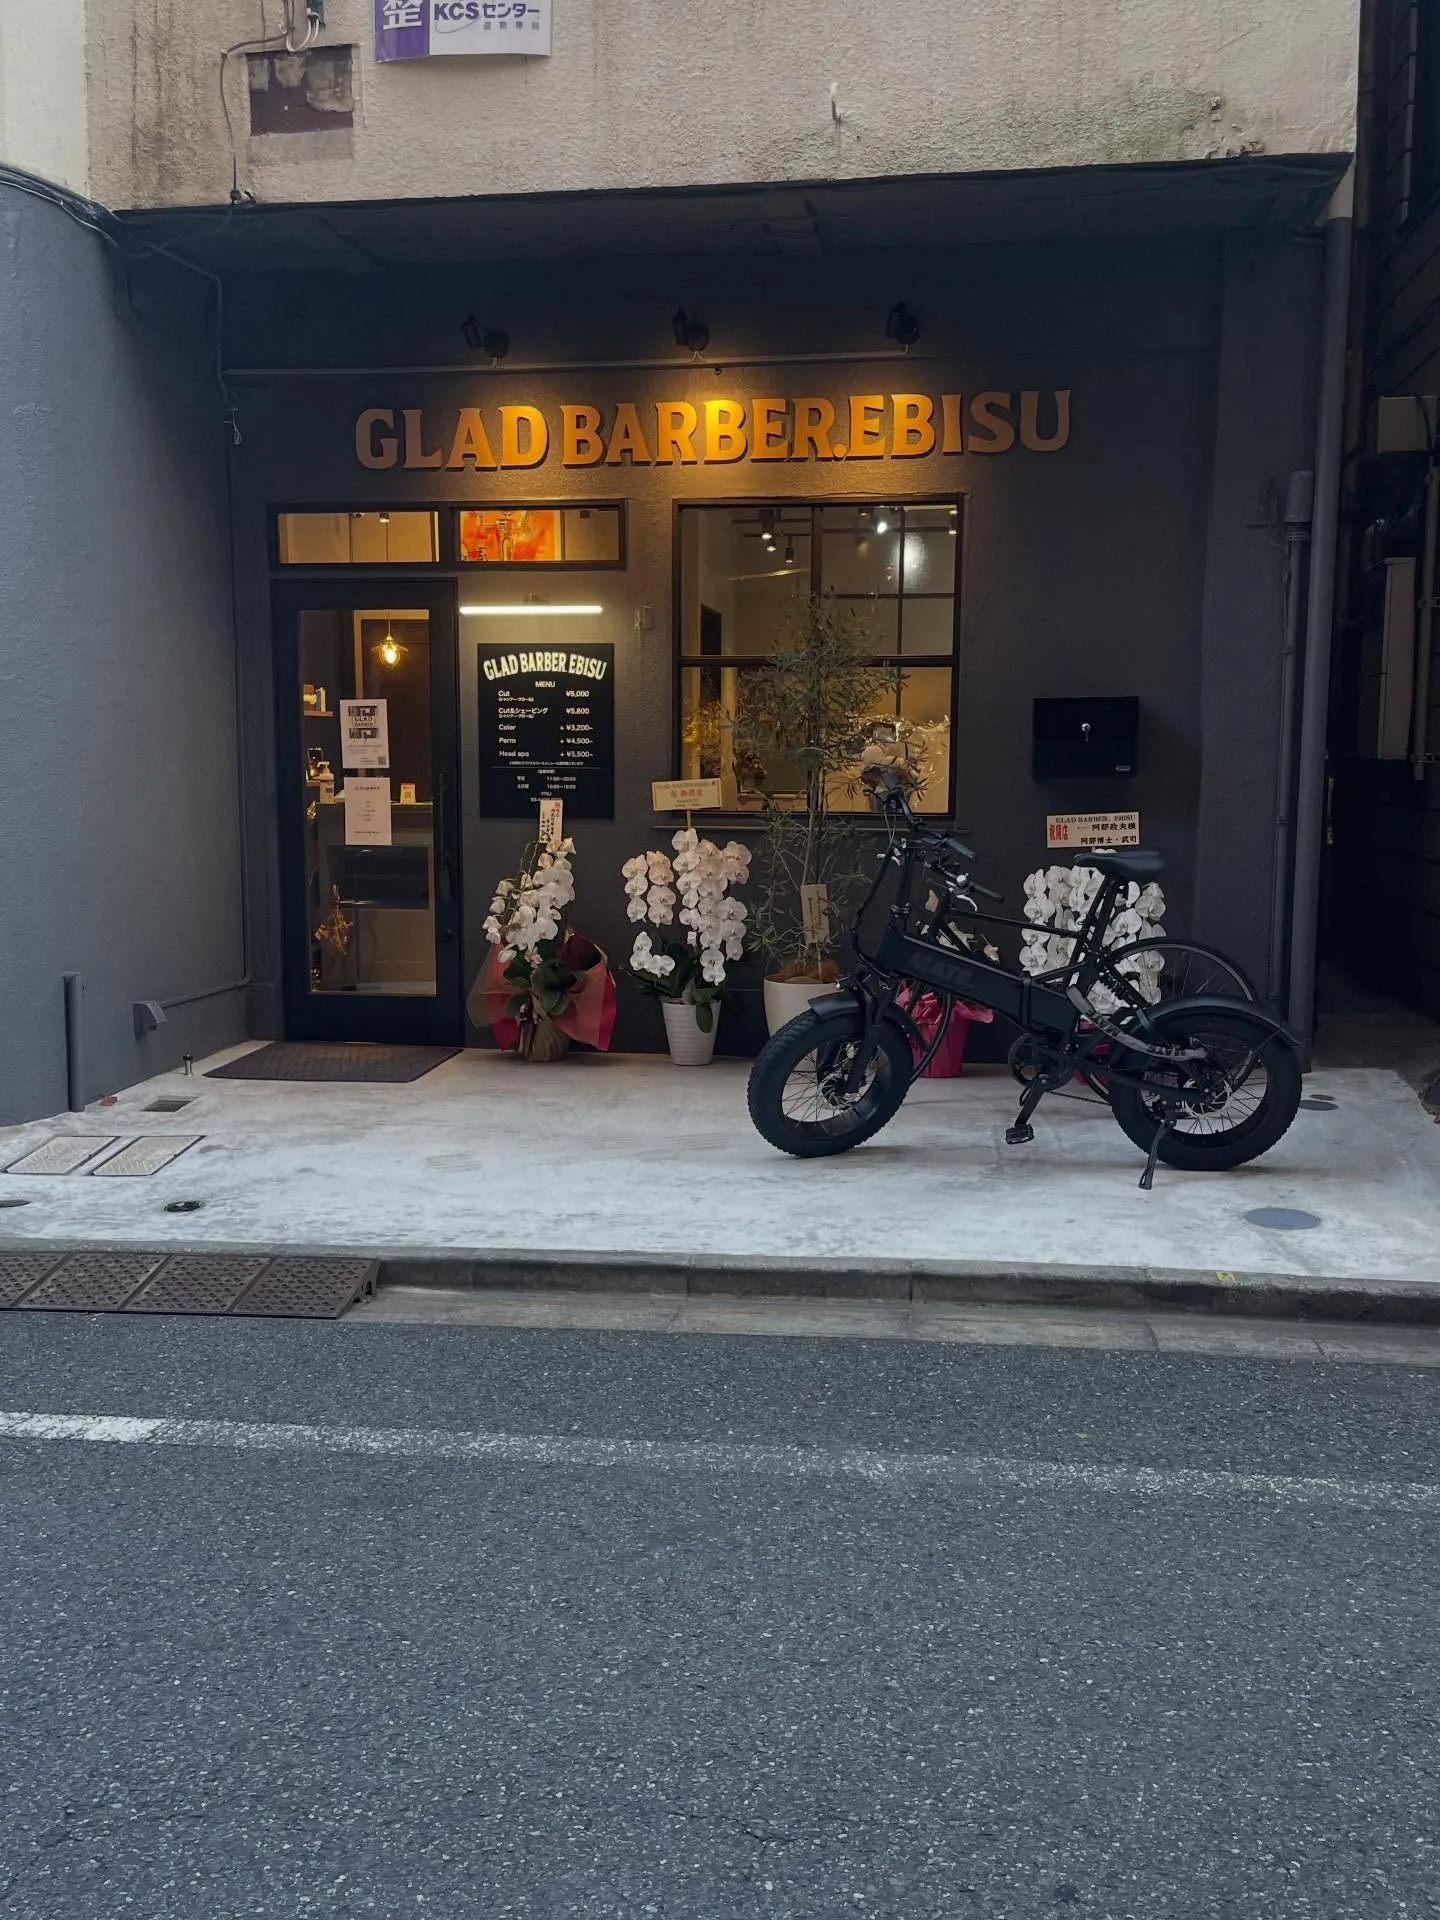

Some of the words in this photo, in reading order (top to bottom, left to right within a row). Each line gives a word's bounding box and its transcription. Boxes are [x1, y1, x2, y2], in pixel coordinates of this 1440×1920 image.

[354, 406, 548, 473] GLAD
[483, 654, 518, 681] GLAD
[568, 653, 608, 681] EBISU
